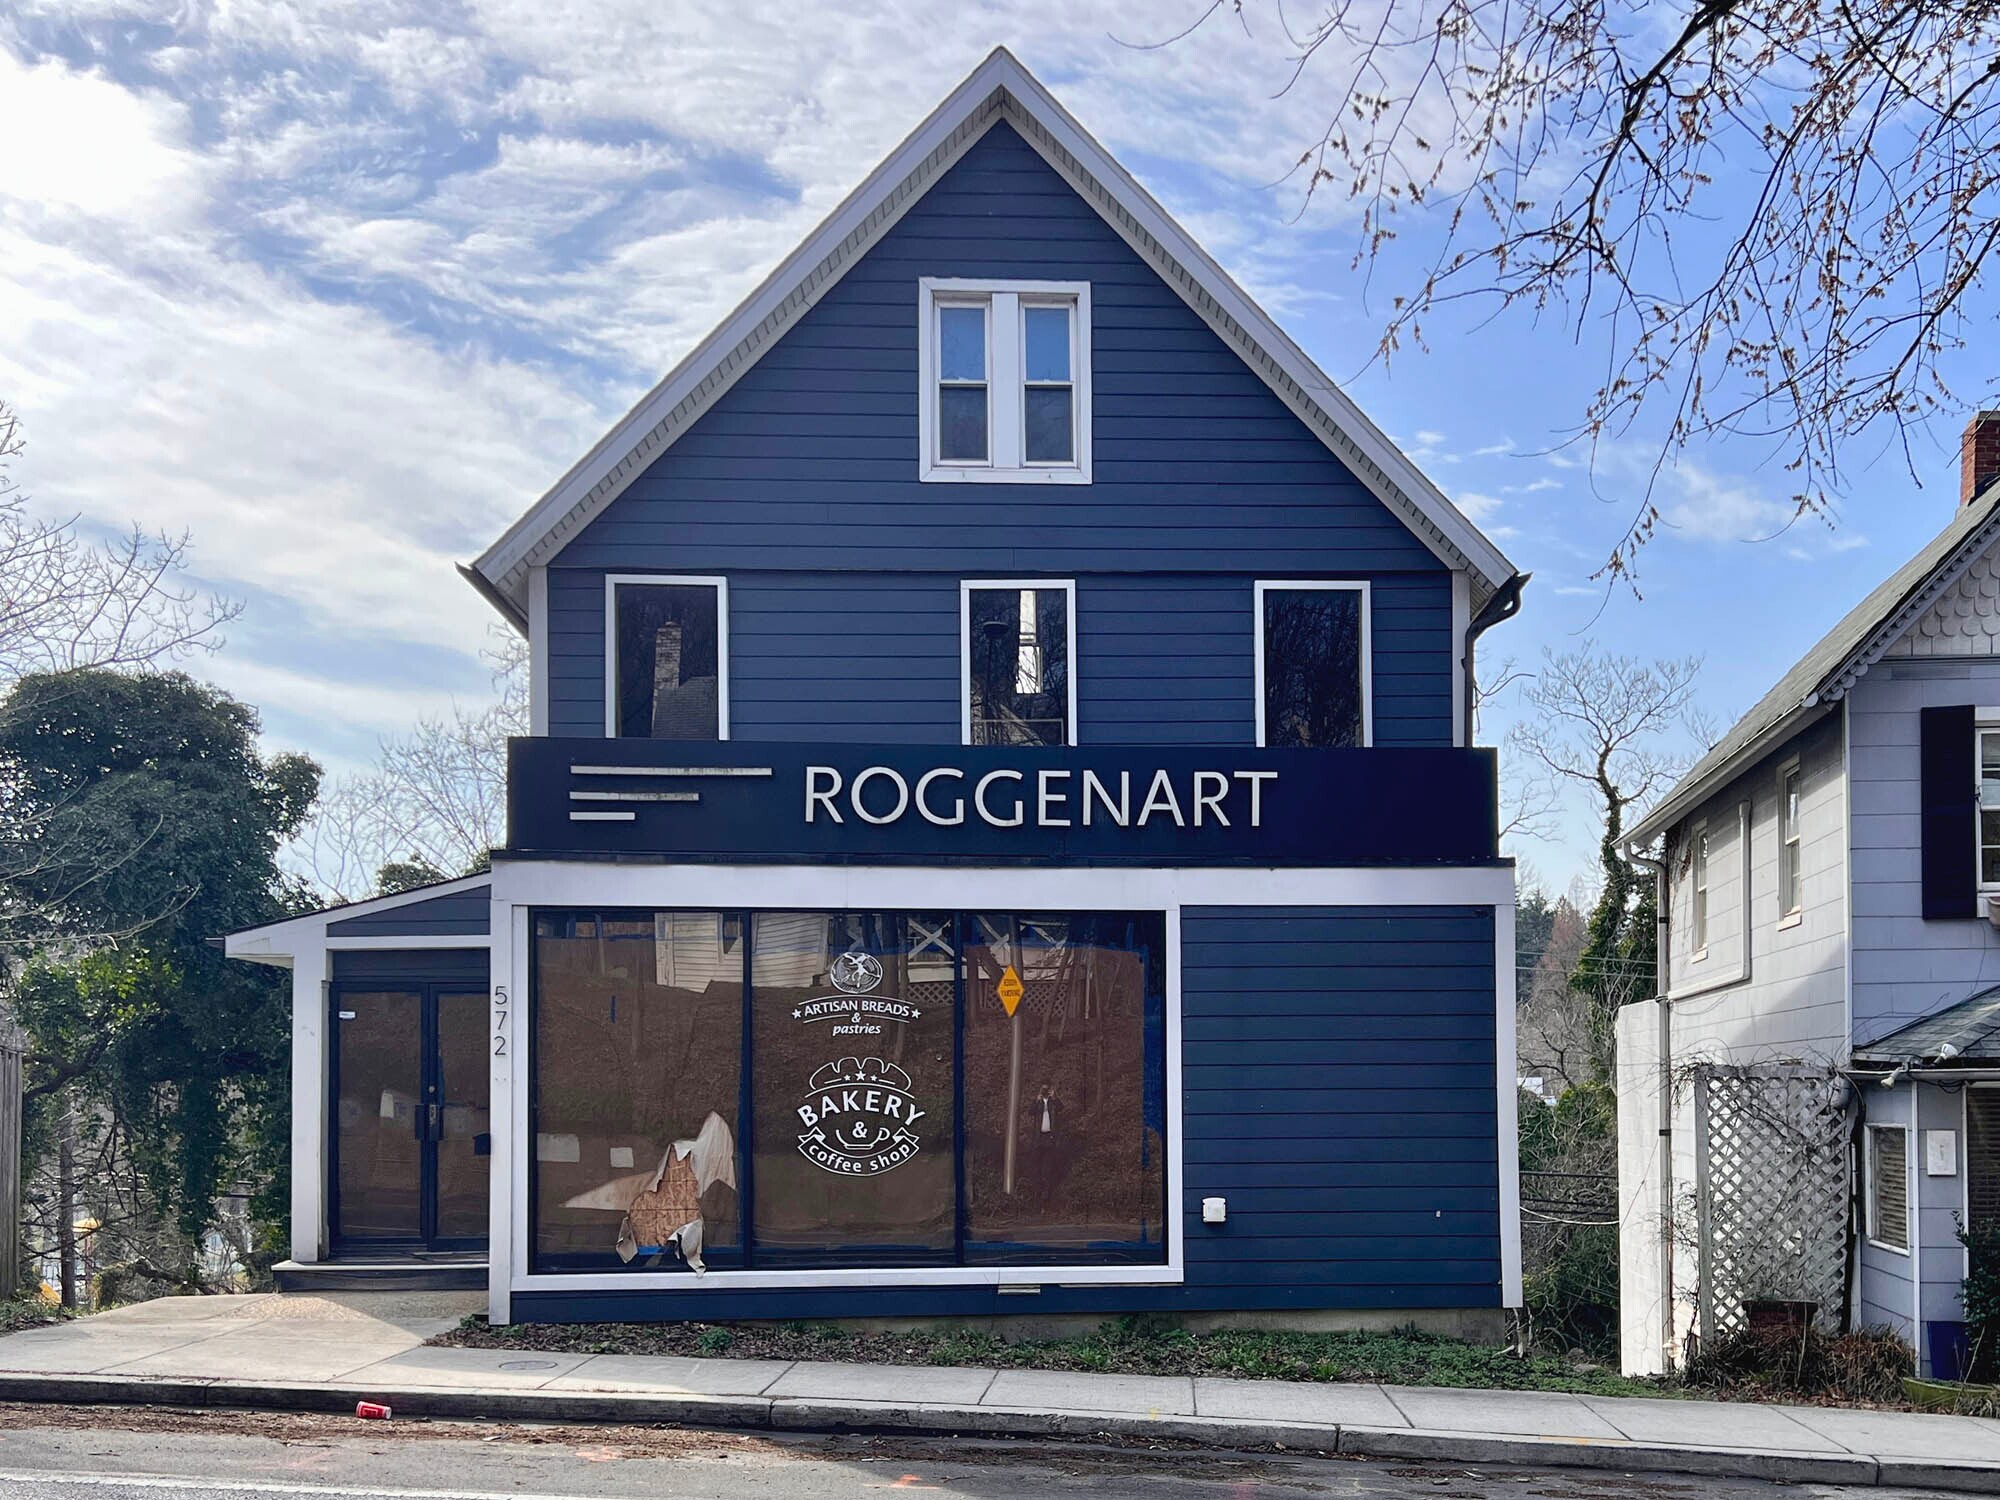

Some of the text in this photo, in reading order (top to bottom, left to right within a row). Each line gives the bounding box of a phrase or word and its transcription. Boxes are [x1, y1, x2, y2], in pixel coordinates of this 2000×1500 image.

[804, 765, 1279, 828] ROGGENART
[493, 985, 508, 1056] 572
[804, 1000, 910, 1018] ARTISAN BREADS
[851, 1012, 861, 1023] &
[832, 1023, 881, 1036] pastries
[797, 1090, 926, 1127] BAKERY
[852, 1121, 868, 1139] &
[808, 1143, 910, 1172] coffee shop
